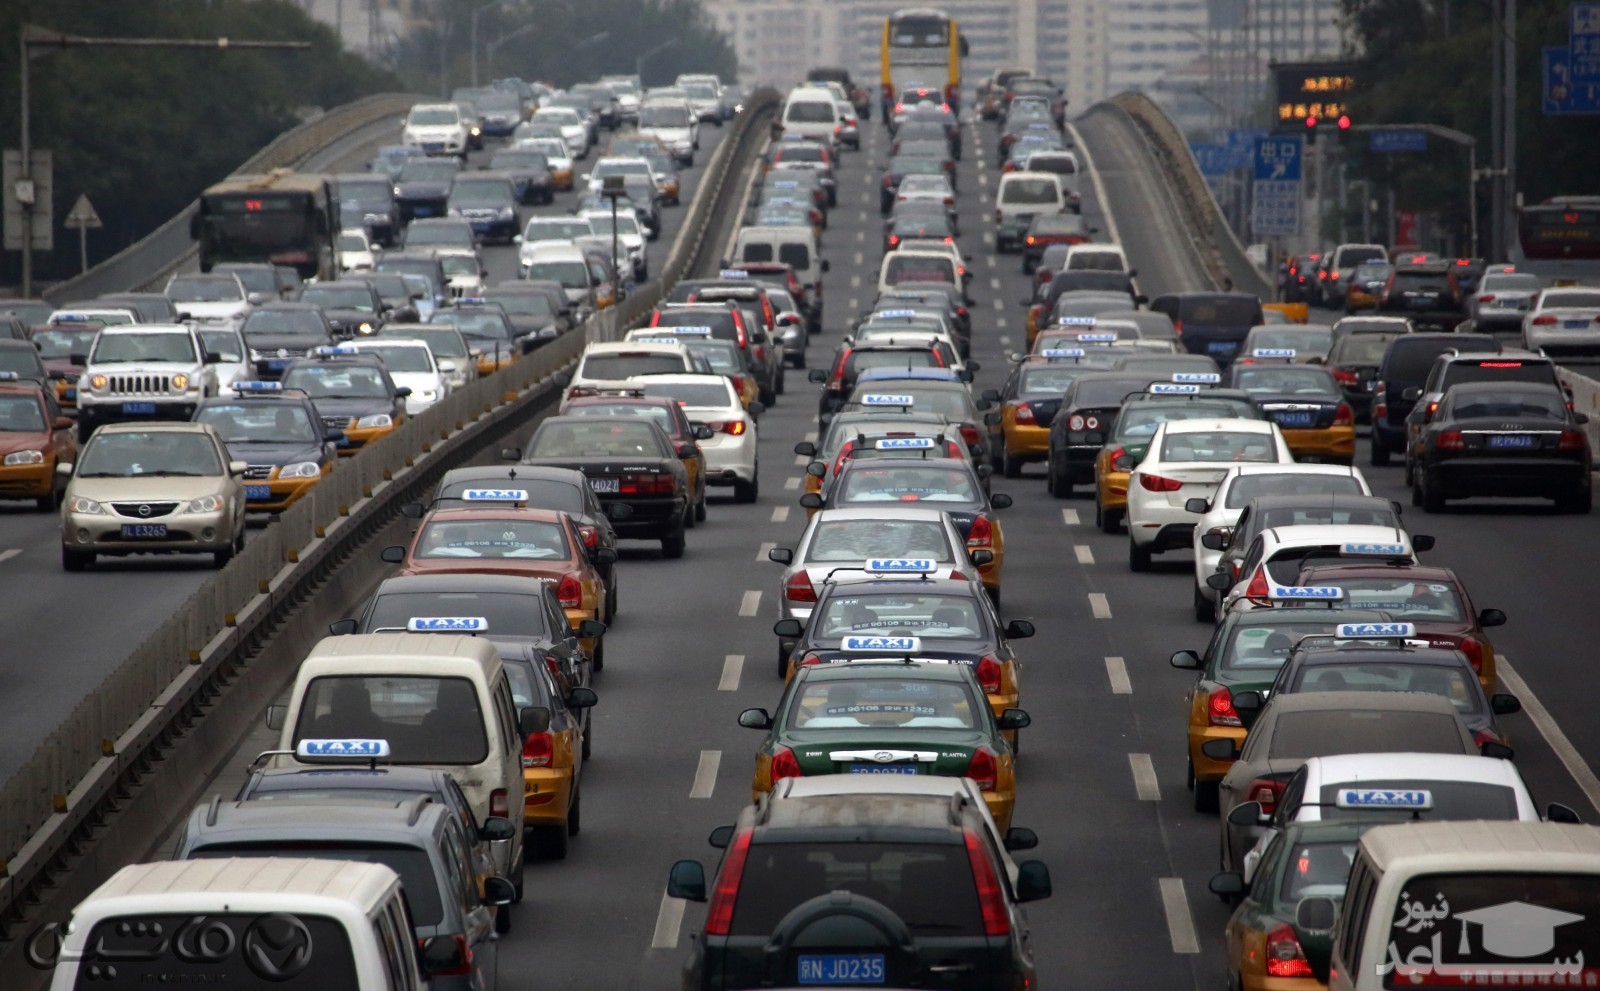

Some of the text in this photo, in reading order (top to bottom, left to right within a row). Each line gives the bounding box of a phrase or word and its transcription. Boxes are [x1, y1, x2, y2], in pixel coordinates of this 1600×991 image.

[1261, 142, 1295, 157] 出口
[473, 490, 518, 498] TAXI
[1352, 543, 1400, 552] TAXI
[874, 559, 926, 567] TAXI
[1281, 586, 1332, 595] TAXI
[426, 618, 475, 627] TAXI
[1348, 624, 1403, 632] TAXI
[853, 638, 909, 647] TAXI
[317, 741, 376, 751] TAXI
[1354, 791, 1419, 802] TAXI
